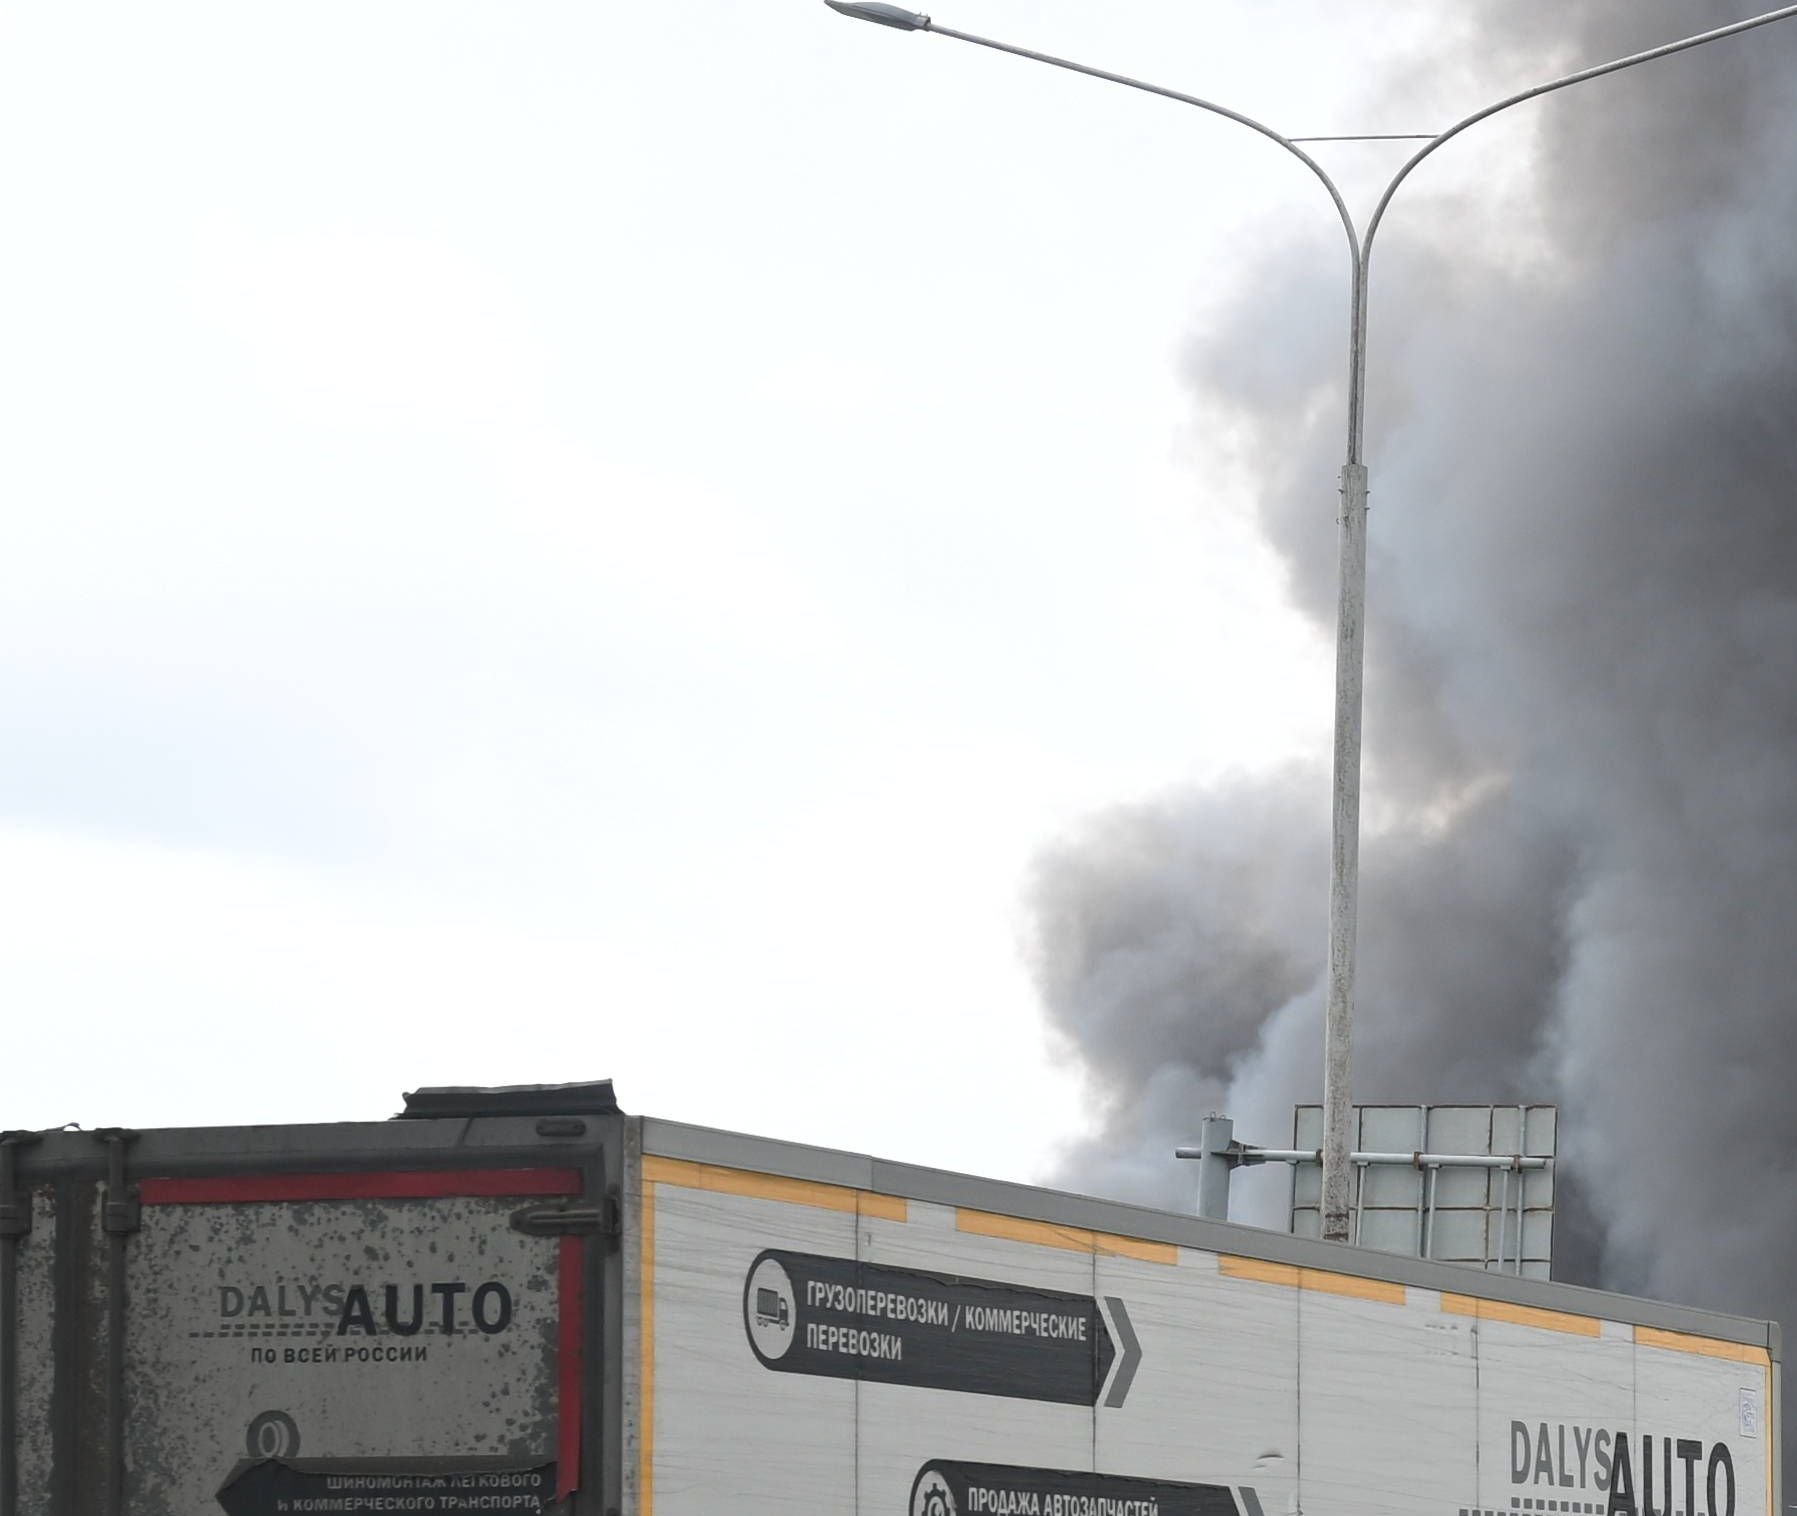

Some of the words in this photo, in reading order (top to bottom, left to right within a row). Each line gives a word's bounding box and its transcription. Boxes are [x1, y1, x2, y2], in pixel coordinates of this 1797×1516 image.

[806, 1279, 949, 1327] ГРУЗОПЕРЕВОЗКИ
[952, 1304, 960, 1332] /
[965, 1305, 1087, 1341] КОММЕРЧЕСКИЕ
[250, 1348, 276, 1363] ПО
[284, 1344, 338, 1363] ВСЕЙ
[344, 1346, 428, 1362] РОССИИ
[806, 1323, 902, 1361] ПЕРЕВОЗКИ
[293, 1497, 435, 1512] КОММЕРЧЕСКОГО
[439, 1495, 541, 1511] ТРАНСПОРТА
[968, 1486, 1040, 1516] ПРОДАЖА
